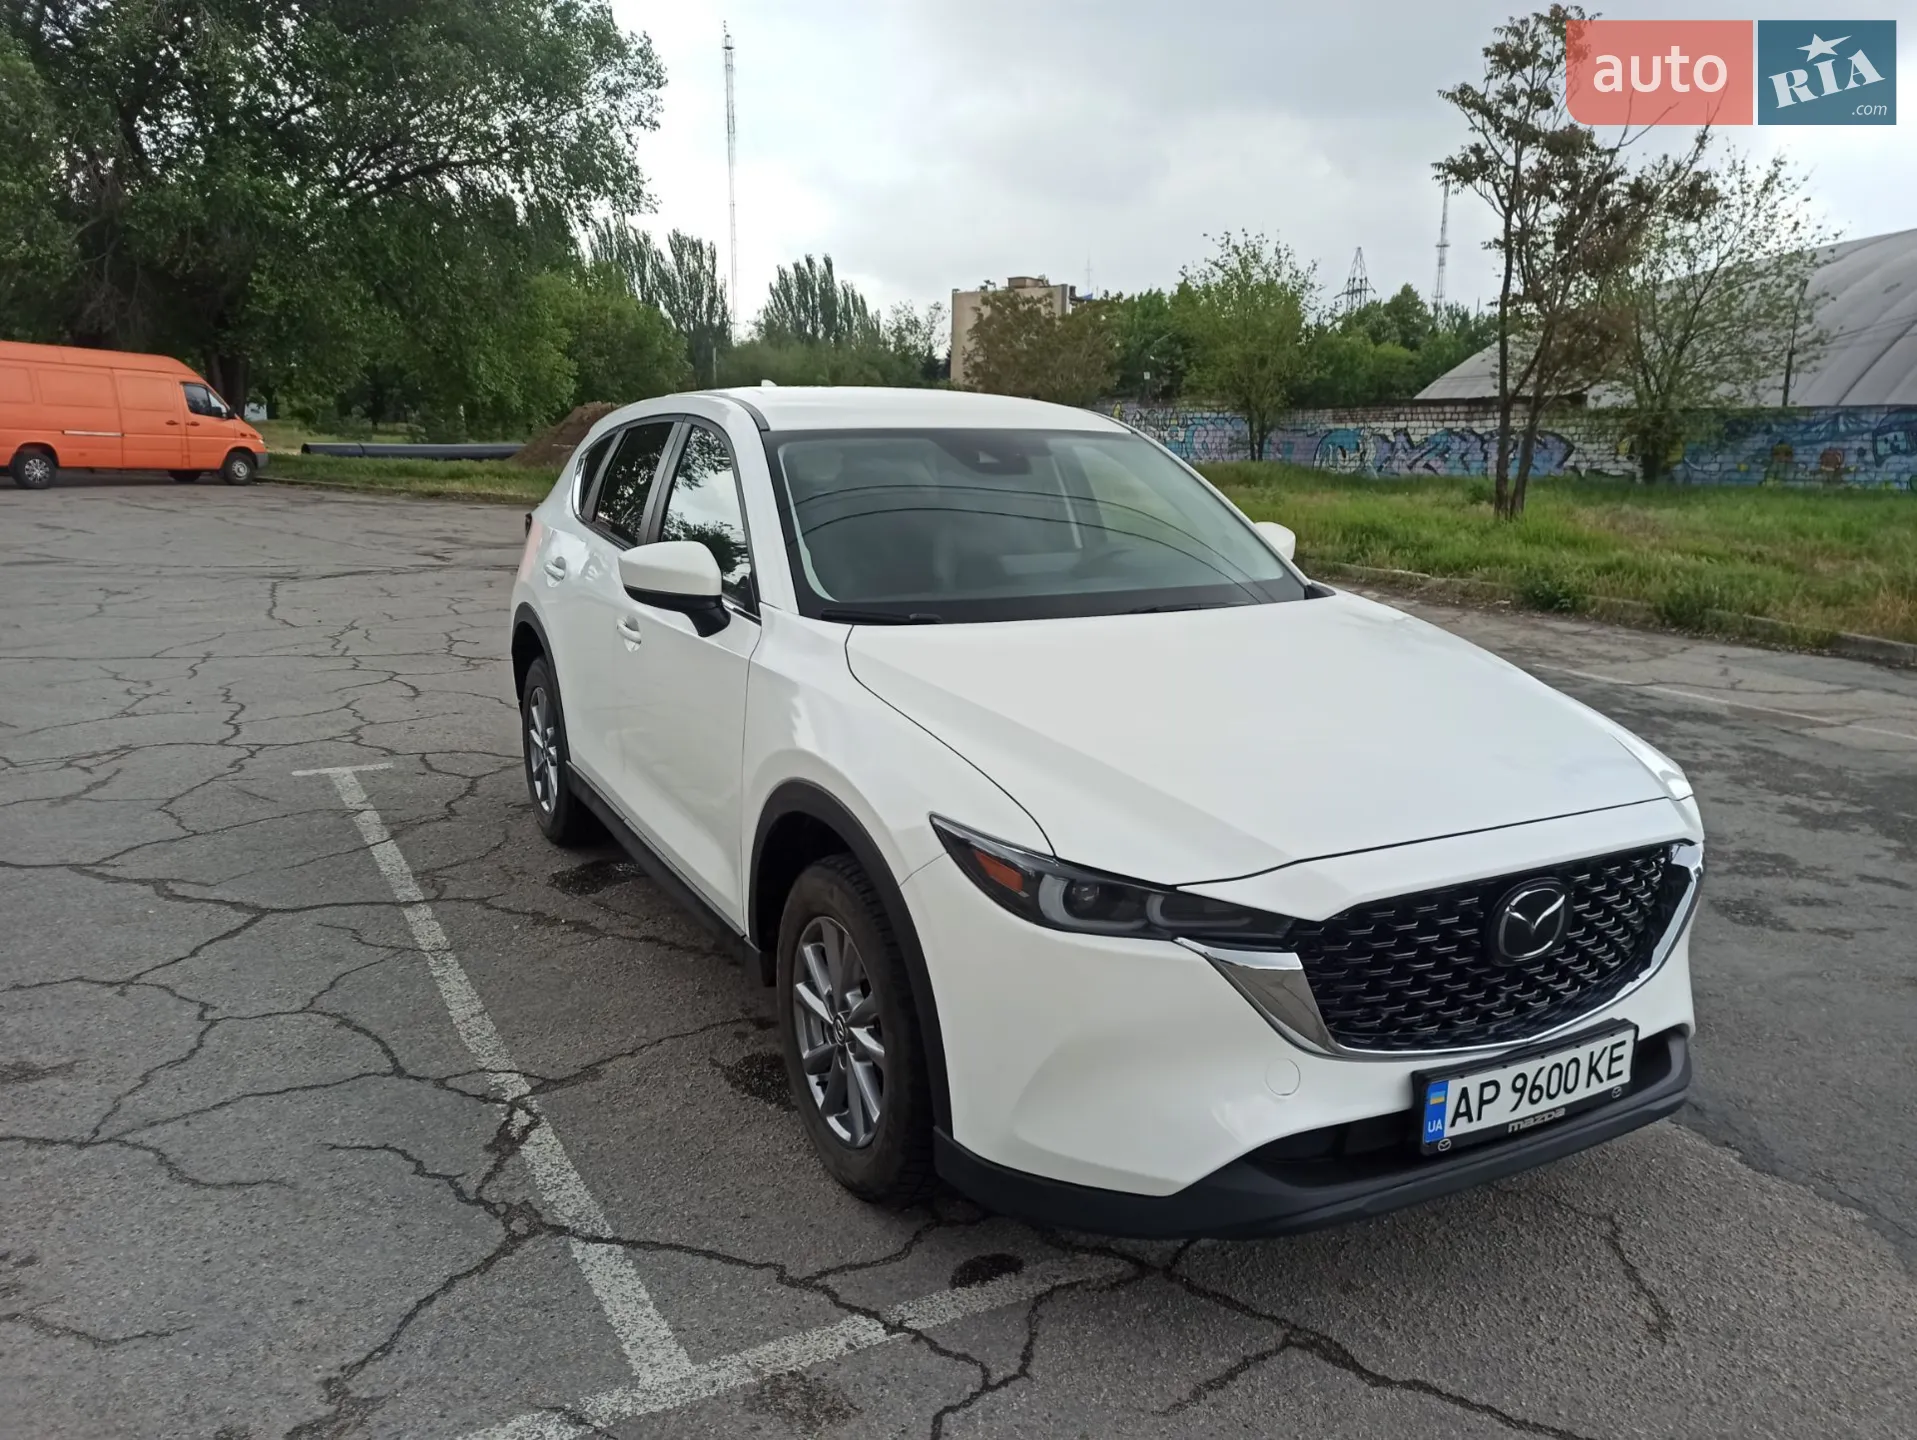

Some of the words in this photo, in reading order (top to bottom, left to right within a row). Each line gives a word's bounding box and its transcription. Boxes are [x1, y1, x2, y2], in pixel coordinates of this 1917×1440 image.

[1449, 1079, 1501, 1128] AP
[1509, 1057, 1581, 1112] 9600
[1585, 1040, 1627, 1089] KE
[1427, 1119, 1443, 1134] UA
